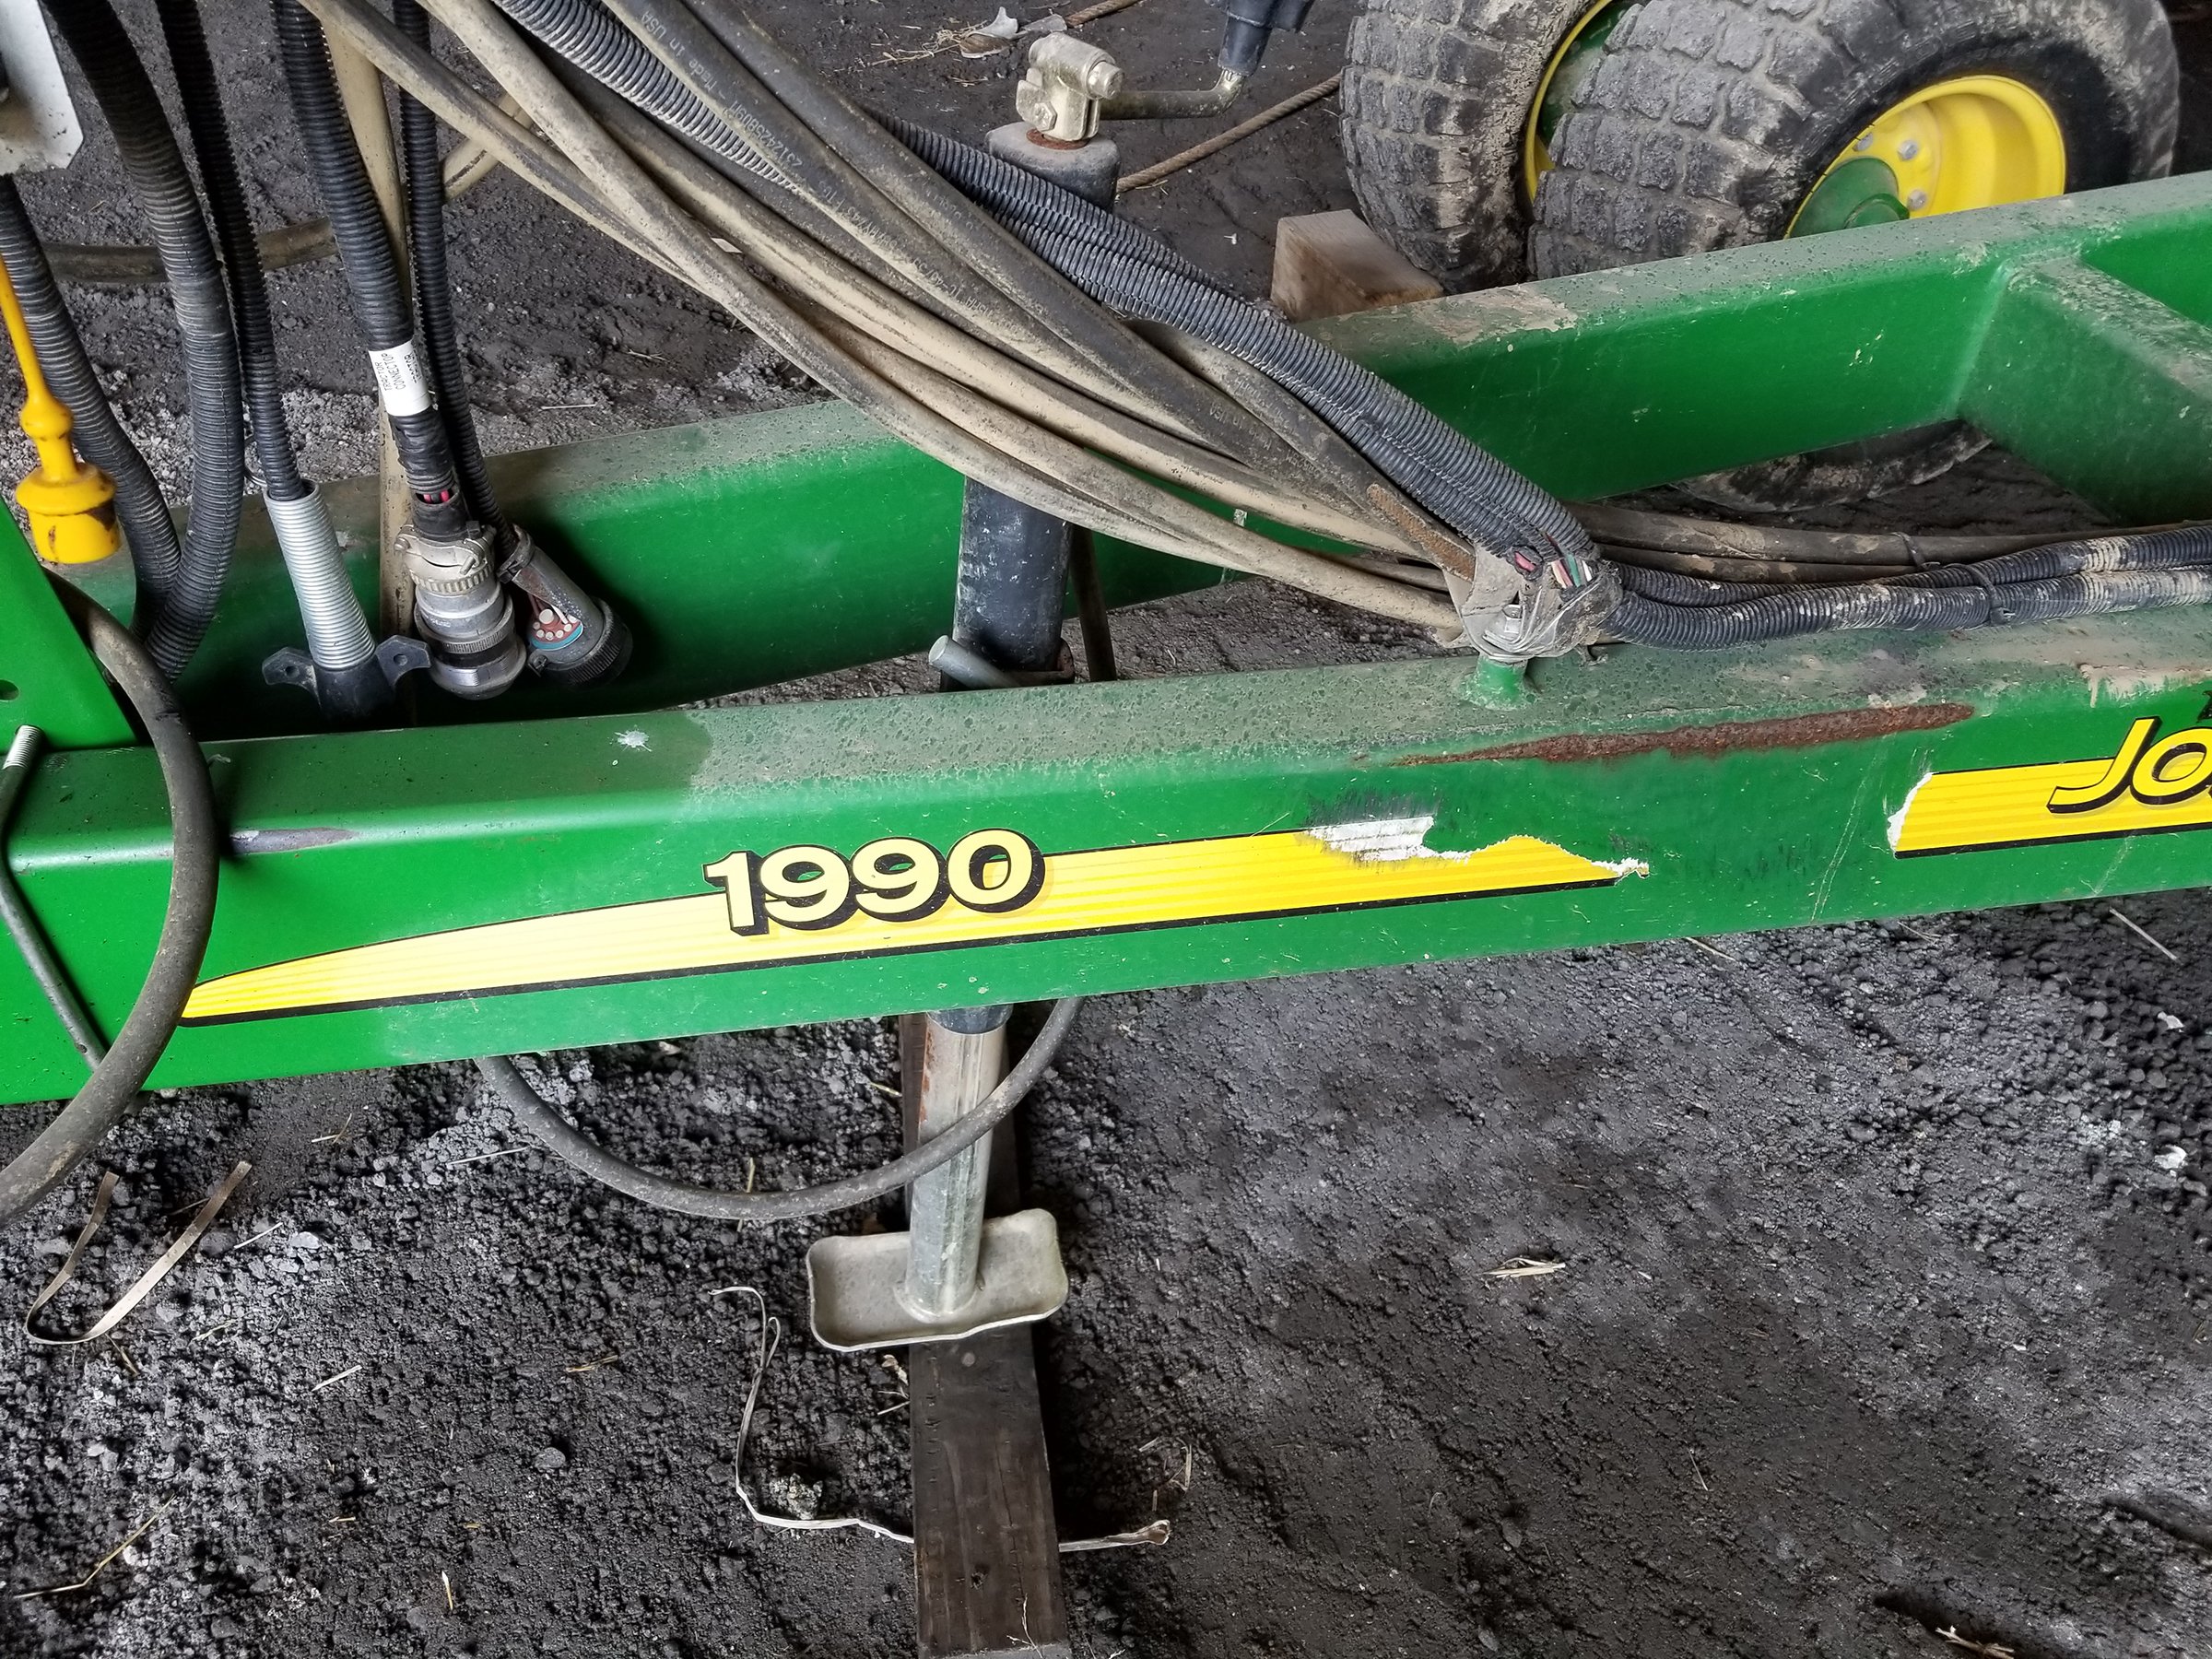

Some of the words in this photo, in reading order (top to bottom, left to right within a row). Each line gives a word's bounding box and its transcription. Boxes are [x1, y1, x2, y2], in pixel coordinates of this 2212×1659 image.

[641, 10, 667, 40] USA
[669, 37, 686, 57] in
[688, 58, 718, 93] Made
[374, 361, 393, 391] TRACTOR
[381, 352, 406, 391] CONNECTOR
[700, 828, 1046, 936] 1990
